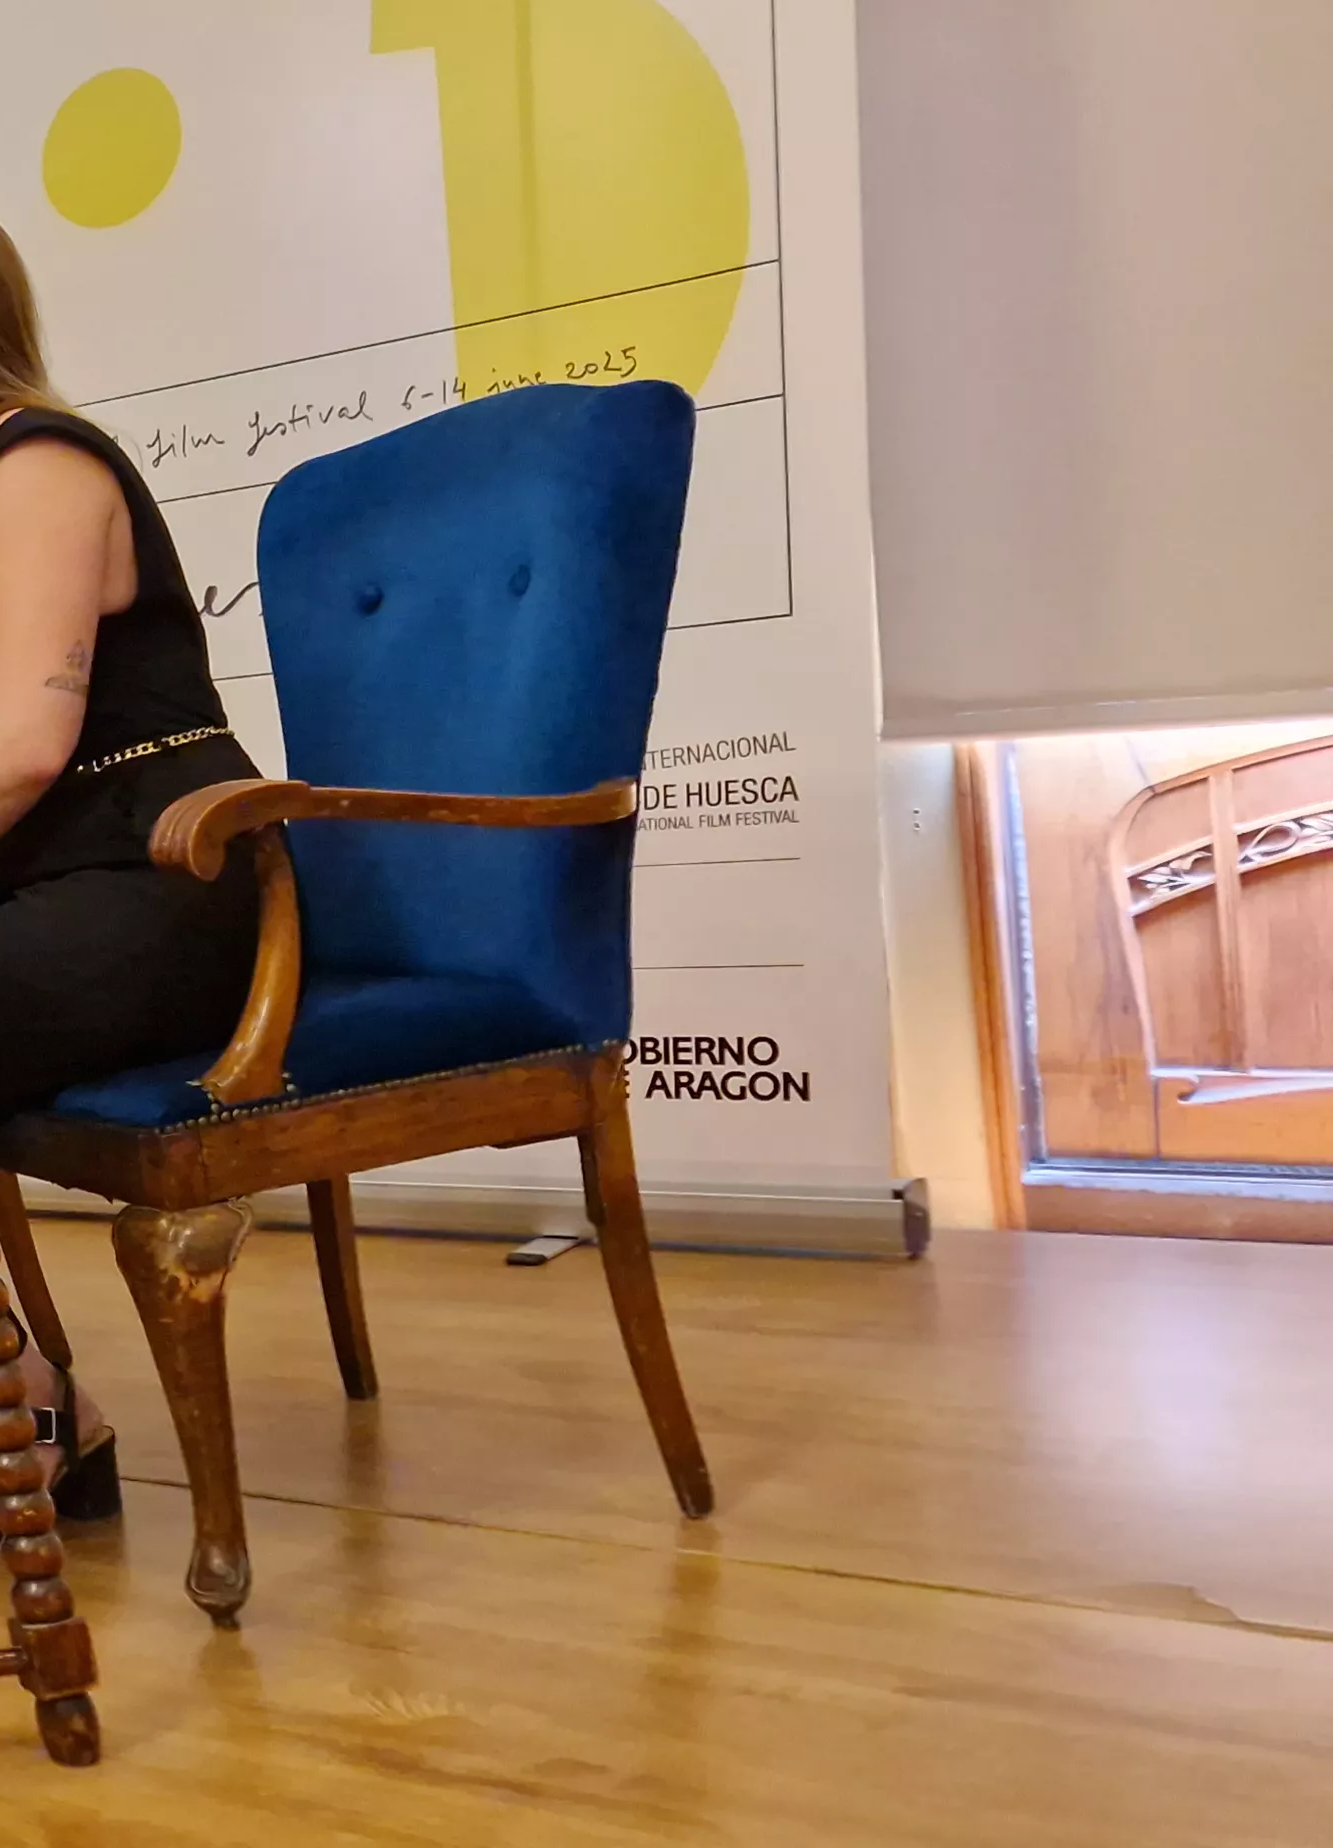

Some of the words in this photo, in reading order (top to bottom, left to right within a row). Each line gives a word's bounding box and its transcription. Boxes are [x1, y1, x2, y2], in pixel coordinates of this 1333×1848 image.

[147, 424, 226, 468] film
[247, 391, 374, 457] festival
[401, 380, 468, 410] 6-14
[565, 346, 638, 378] 2025
[644, 784, 678, 811] DE
[686, 775, 800, 808] HUESCA
[699, 813, 732, 829] FILM
[735, 809, 800, 827] FESTIVAL
[645, 1070, 812, 1102] ARAGON
